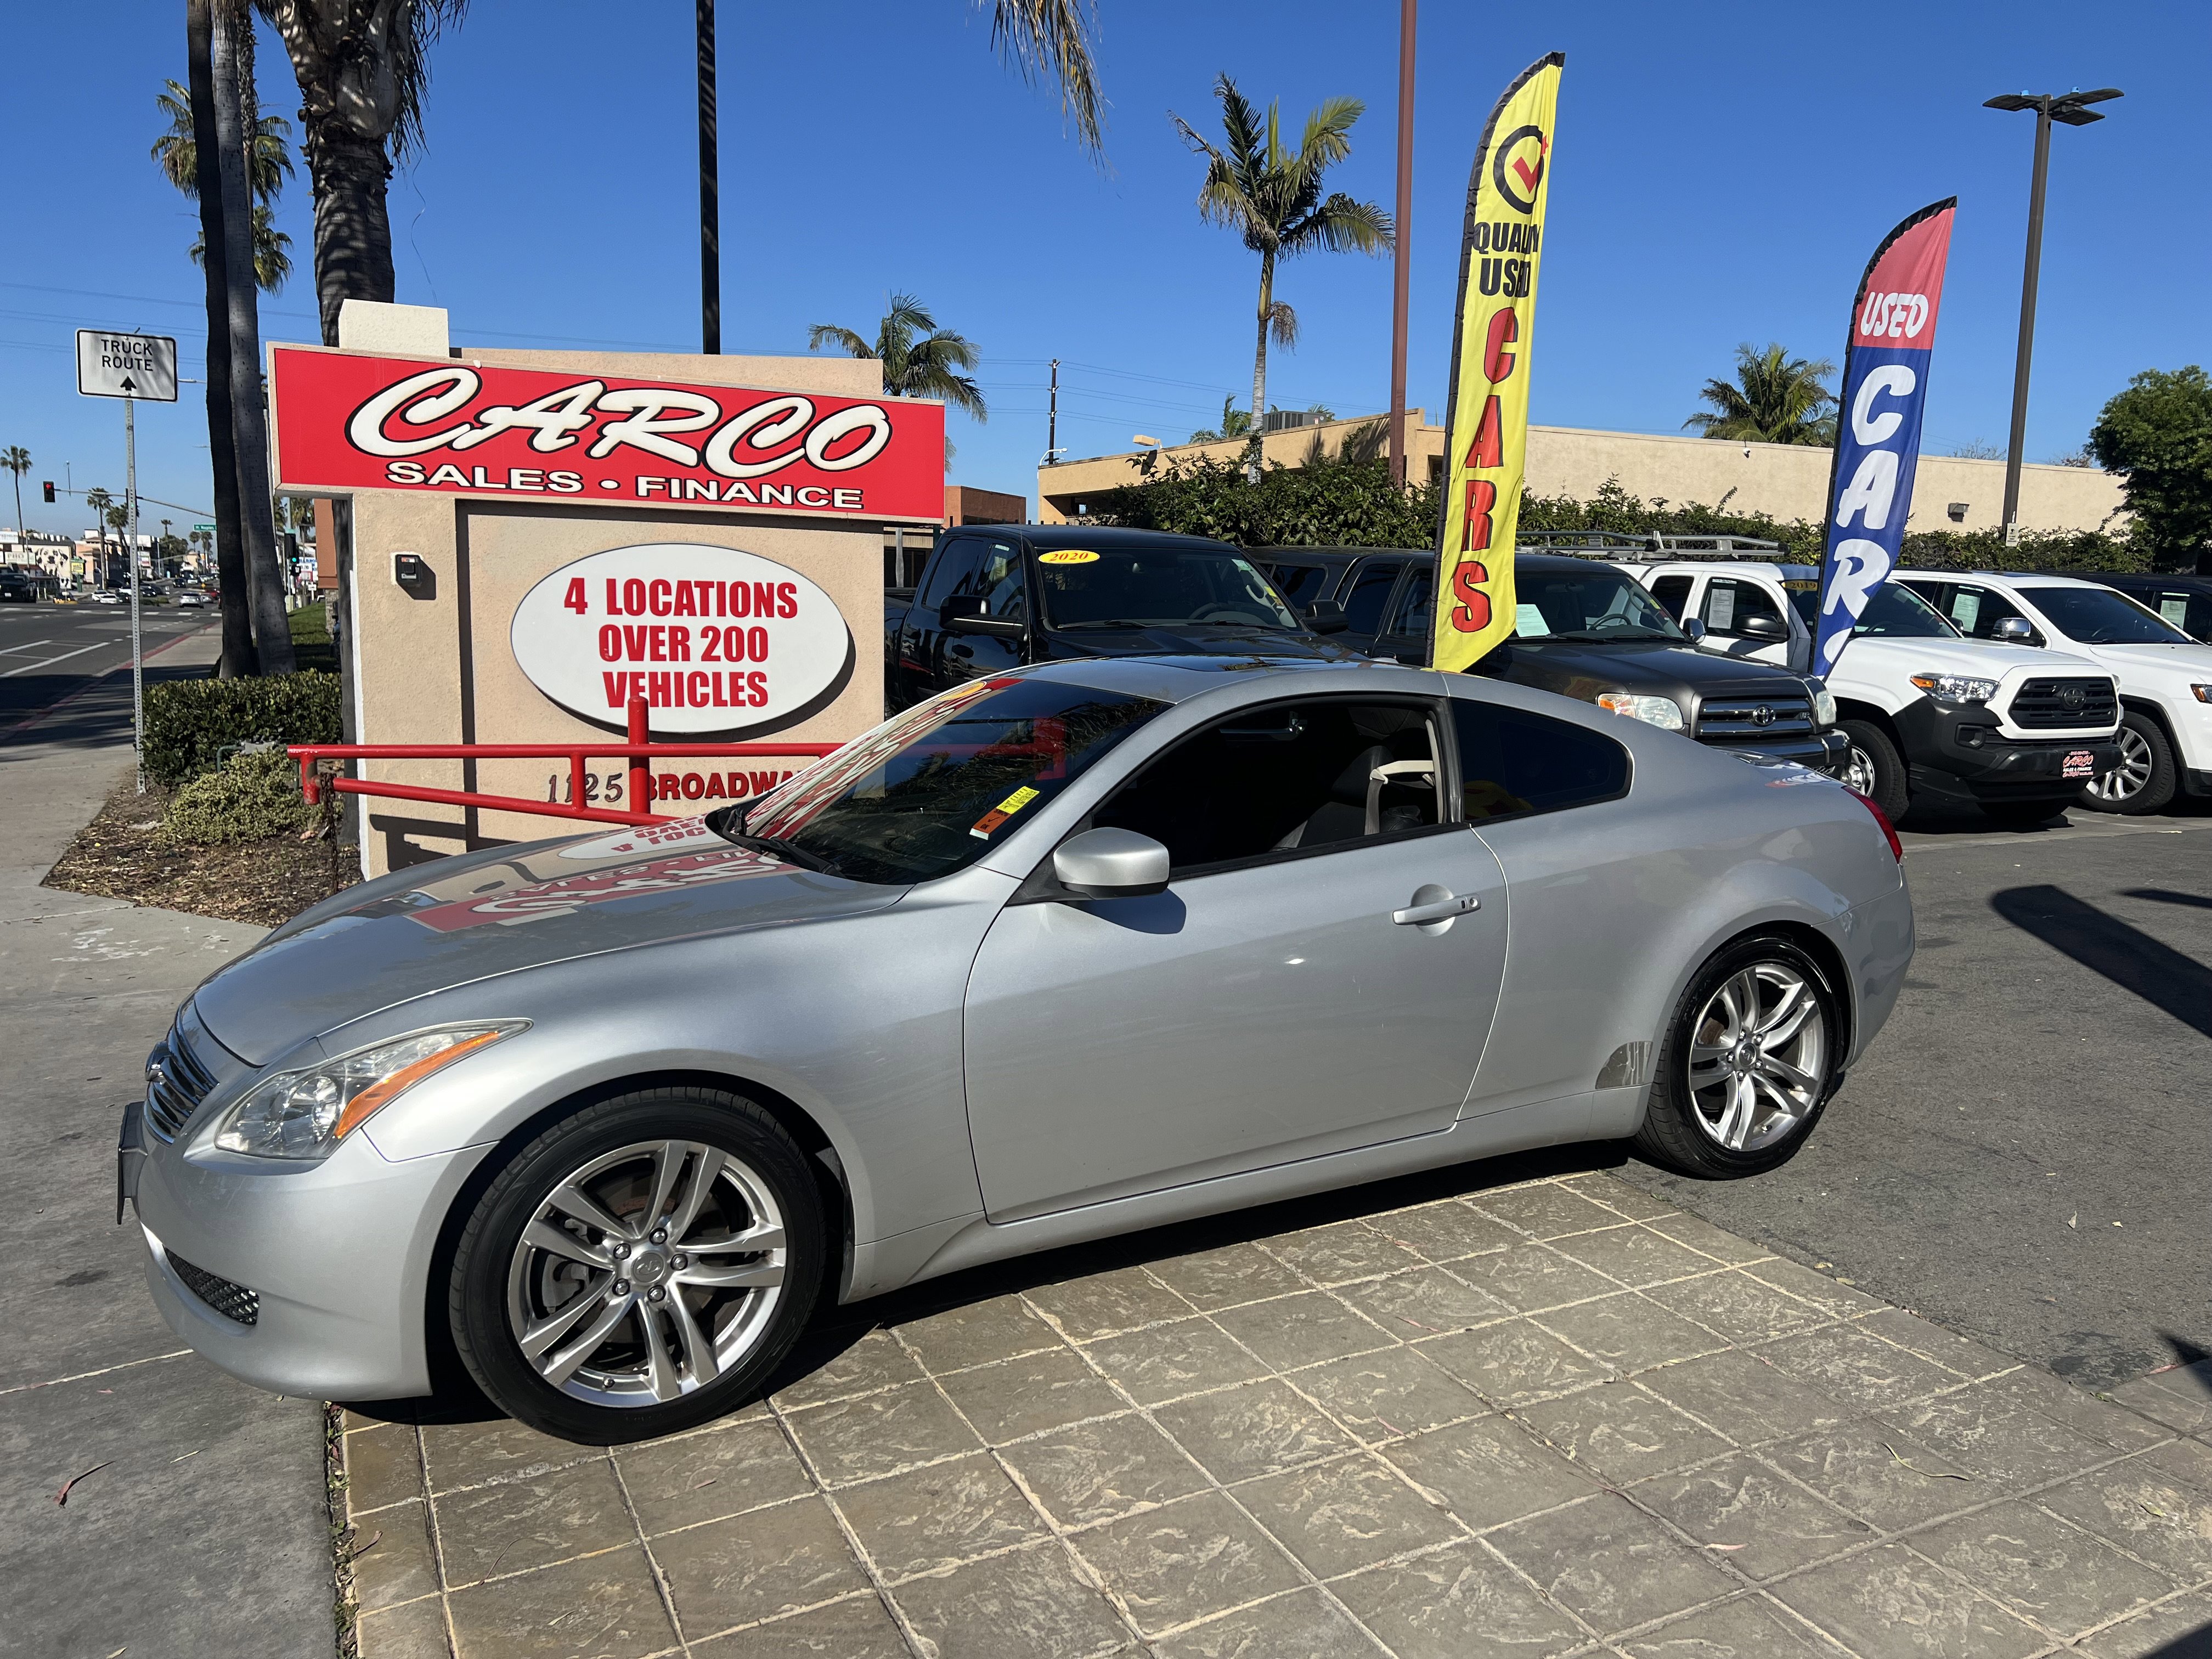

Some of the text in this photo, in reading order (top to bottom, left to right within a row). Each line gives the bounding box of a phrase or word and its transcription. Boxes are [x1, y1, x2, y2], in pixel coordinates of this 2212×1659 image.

[1860, 291, 1929, 338] USED
[101, 339, 153, 356] TRUCK
[102, 355, 153, 371] ROUTE
[345, 366, 892, 479] CARCO
[386, 461, 865, 510] SALES FINANCE
[1452, 306, 1519, 633] CARS
[1049, 552, 1088, 561] 2020
[564, 577, 798, 619] 4 LOCATIONS
[599, 624, 769, 663] OVER 200
[602, 670, 769, 708] VEHICLES
[2063, 754, 2094, 768] CARCO
